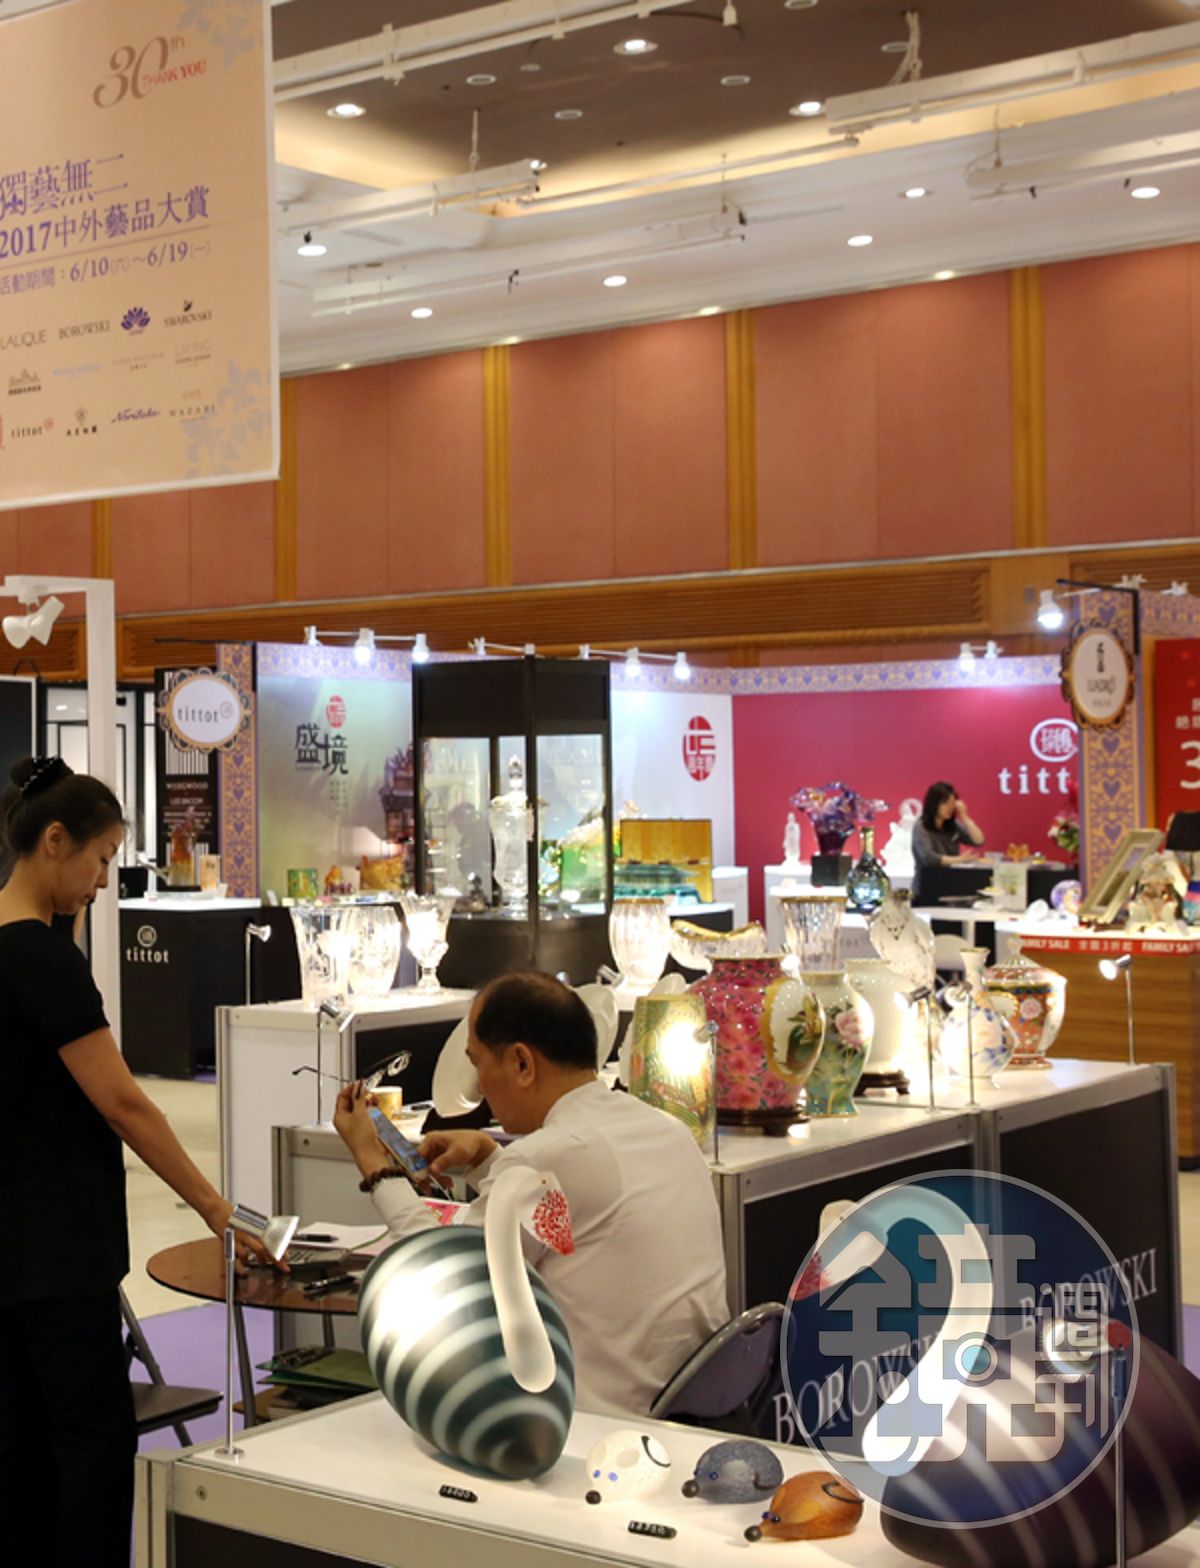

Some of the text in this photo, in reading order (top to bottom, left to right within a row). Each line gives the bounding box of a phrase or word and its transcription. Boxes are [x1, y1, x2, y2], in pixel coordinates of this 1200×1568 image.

[142, 59, 207, 87] THANK YOU
[0, 330, 48, 351] LALIQUE
[58, 320, 111, 341] BOROWSKI
[177, 706, 219, 722] tittot
[295, 722, 349, 776] 盛境
[125, 946, 169, 964] tittot
